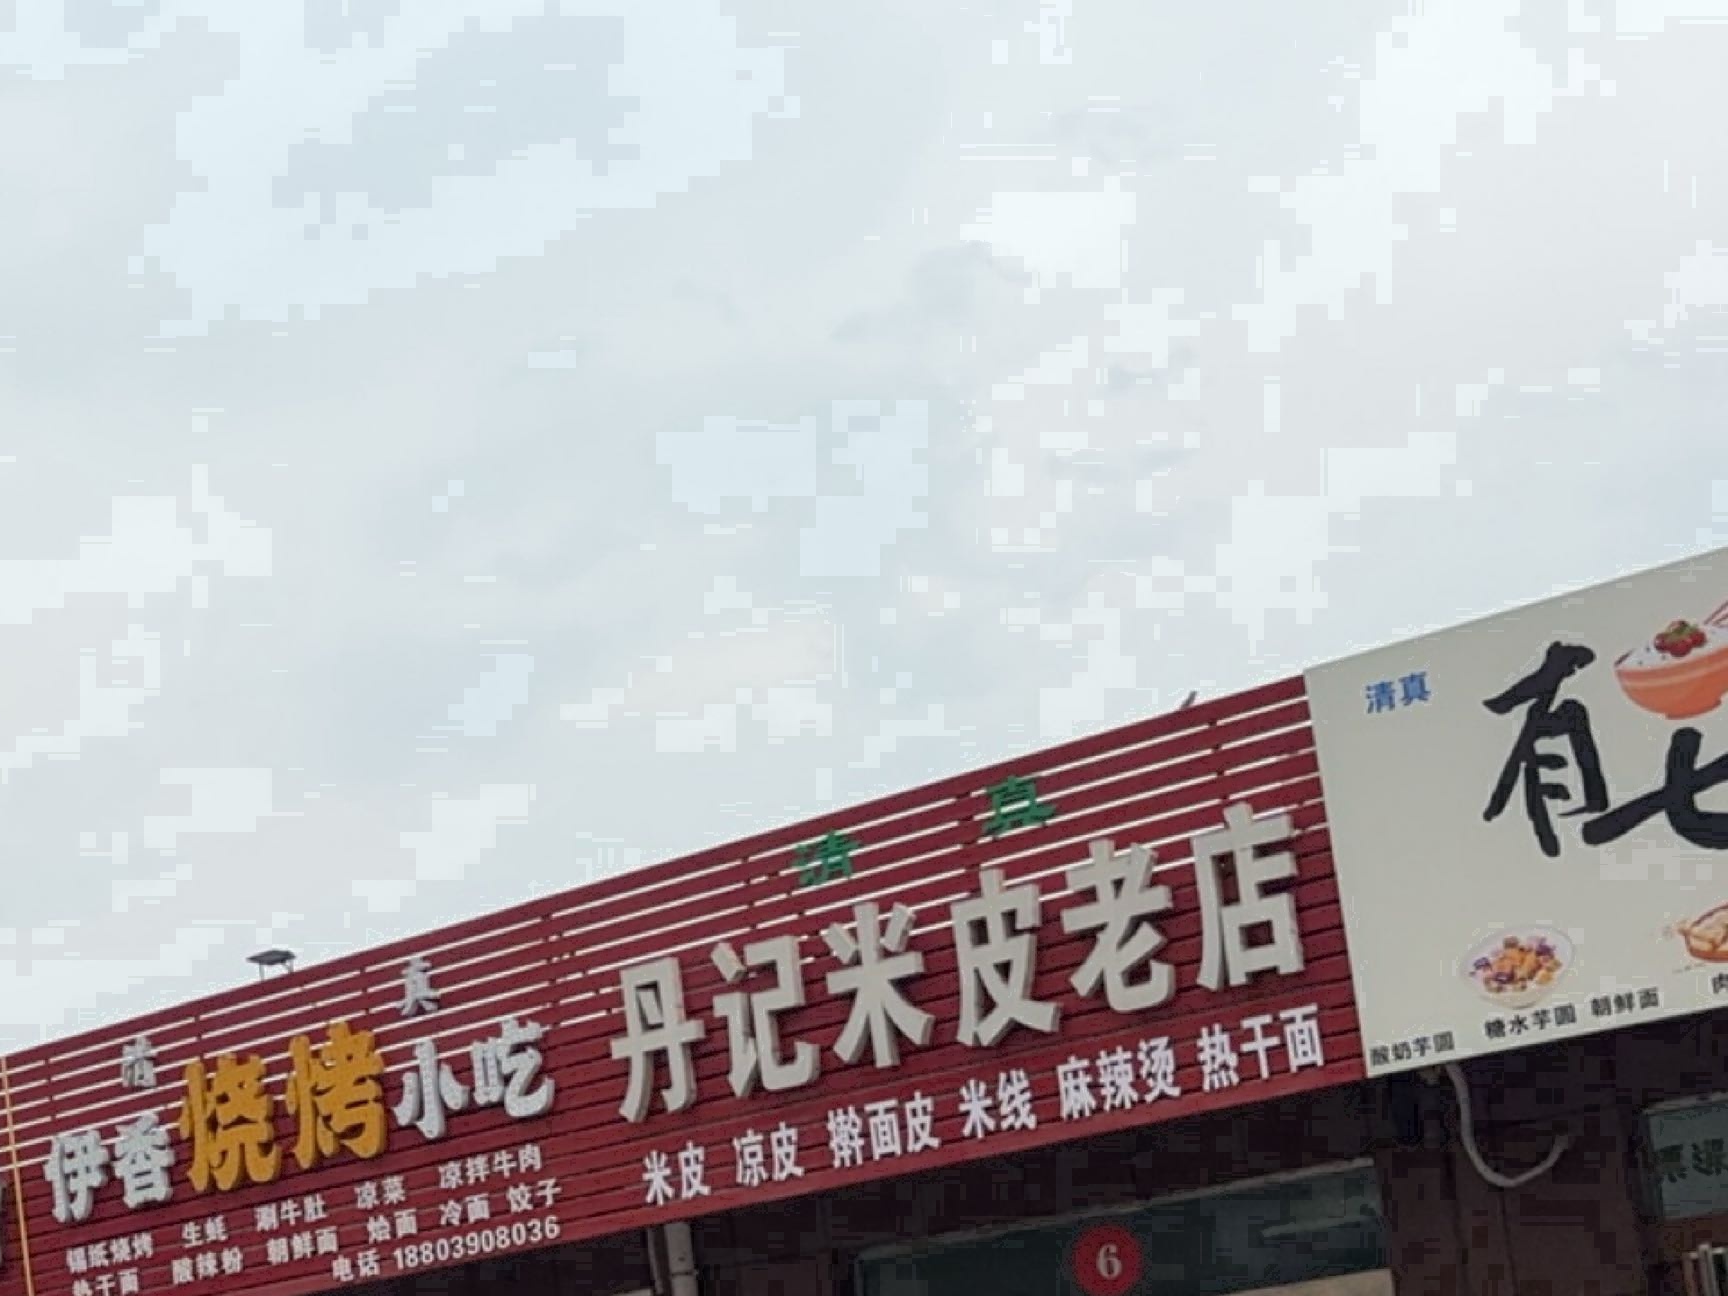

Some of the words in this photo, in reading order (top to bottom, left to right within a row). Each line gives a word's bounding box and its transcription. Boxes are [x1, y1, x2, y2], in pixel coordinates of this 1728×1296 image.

[1364, 670, 1433, 715] 清真
[609, 801, 1306, 1125] 丹记米皮老店
[43, 1019, 555, 1223] 伊香烧烤小吃
[642, 1140, 711, 1206] 米皮
[732, 1121, 805, 1187] 凉皮
[826, 1091, 941, 1170] 擀面皮
[958, 1069, 1038, 1139] 米线
[1056, 1038, 1182, 1120] 麻辣烫
[1197, 1003, 1324, 1092] 热干面
[438, 1143, 542, 1190] 凉拌牛肉
[507, 1177, 562, 1214] 饺子
[332, 1248, 381, 1283] 电话
[393, 1214, 561, 1270] 18803908036
[1096, 1244, 1123, 1280] 6
